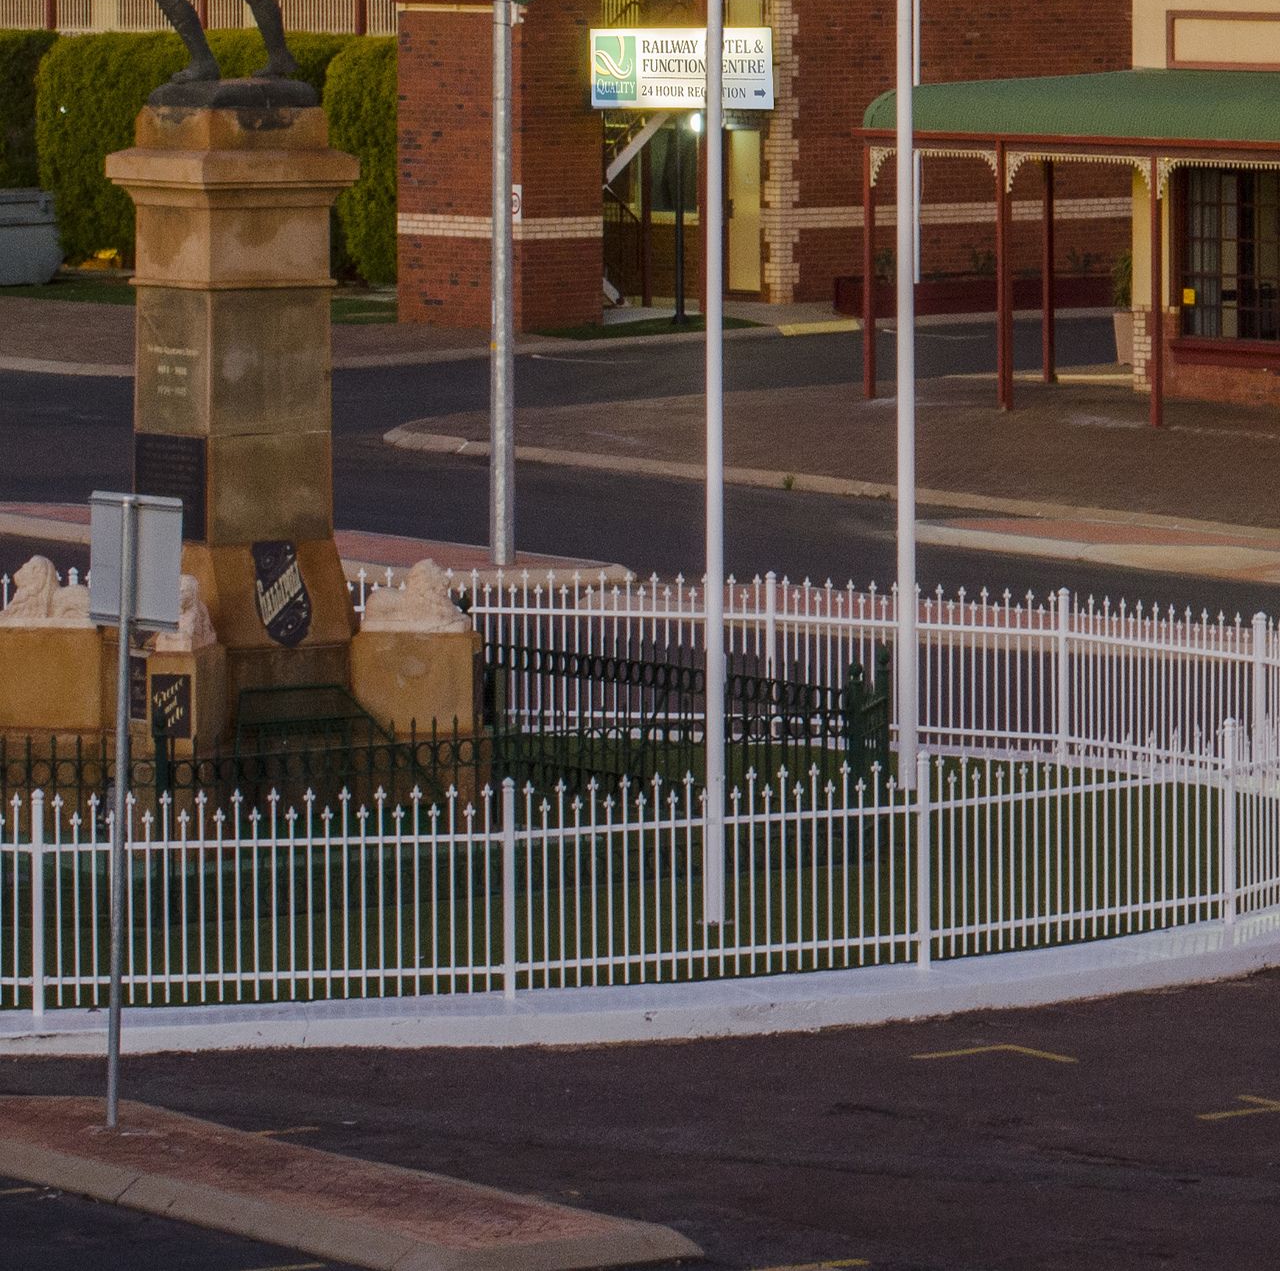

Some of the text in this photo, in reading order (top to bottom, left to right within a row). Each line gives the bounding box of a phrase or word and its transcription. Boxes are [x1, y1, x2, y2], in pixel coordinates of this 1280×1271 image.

[642, 39, 764, 54] RAILWAY TEL &
[642, 58, 765, 74] FUNCTION ENTRE
[642, 85, 654, 96] 24
[655, 86, 684, 97] HOUR
